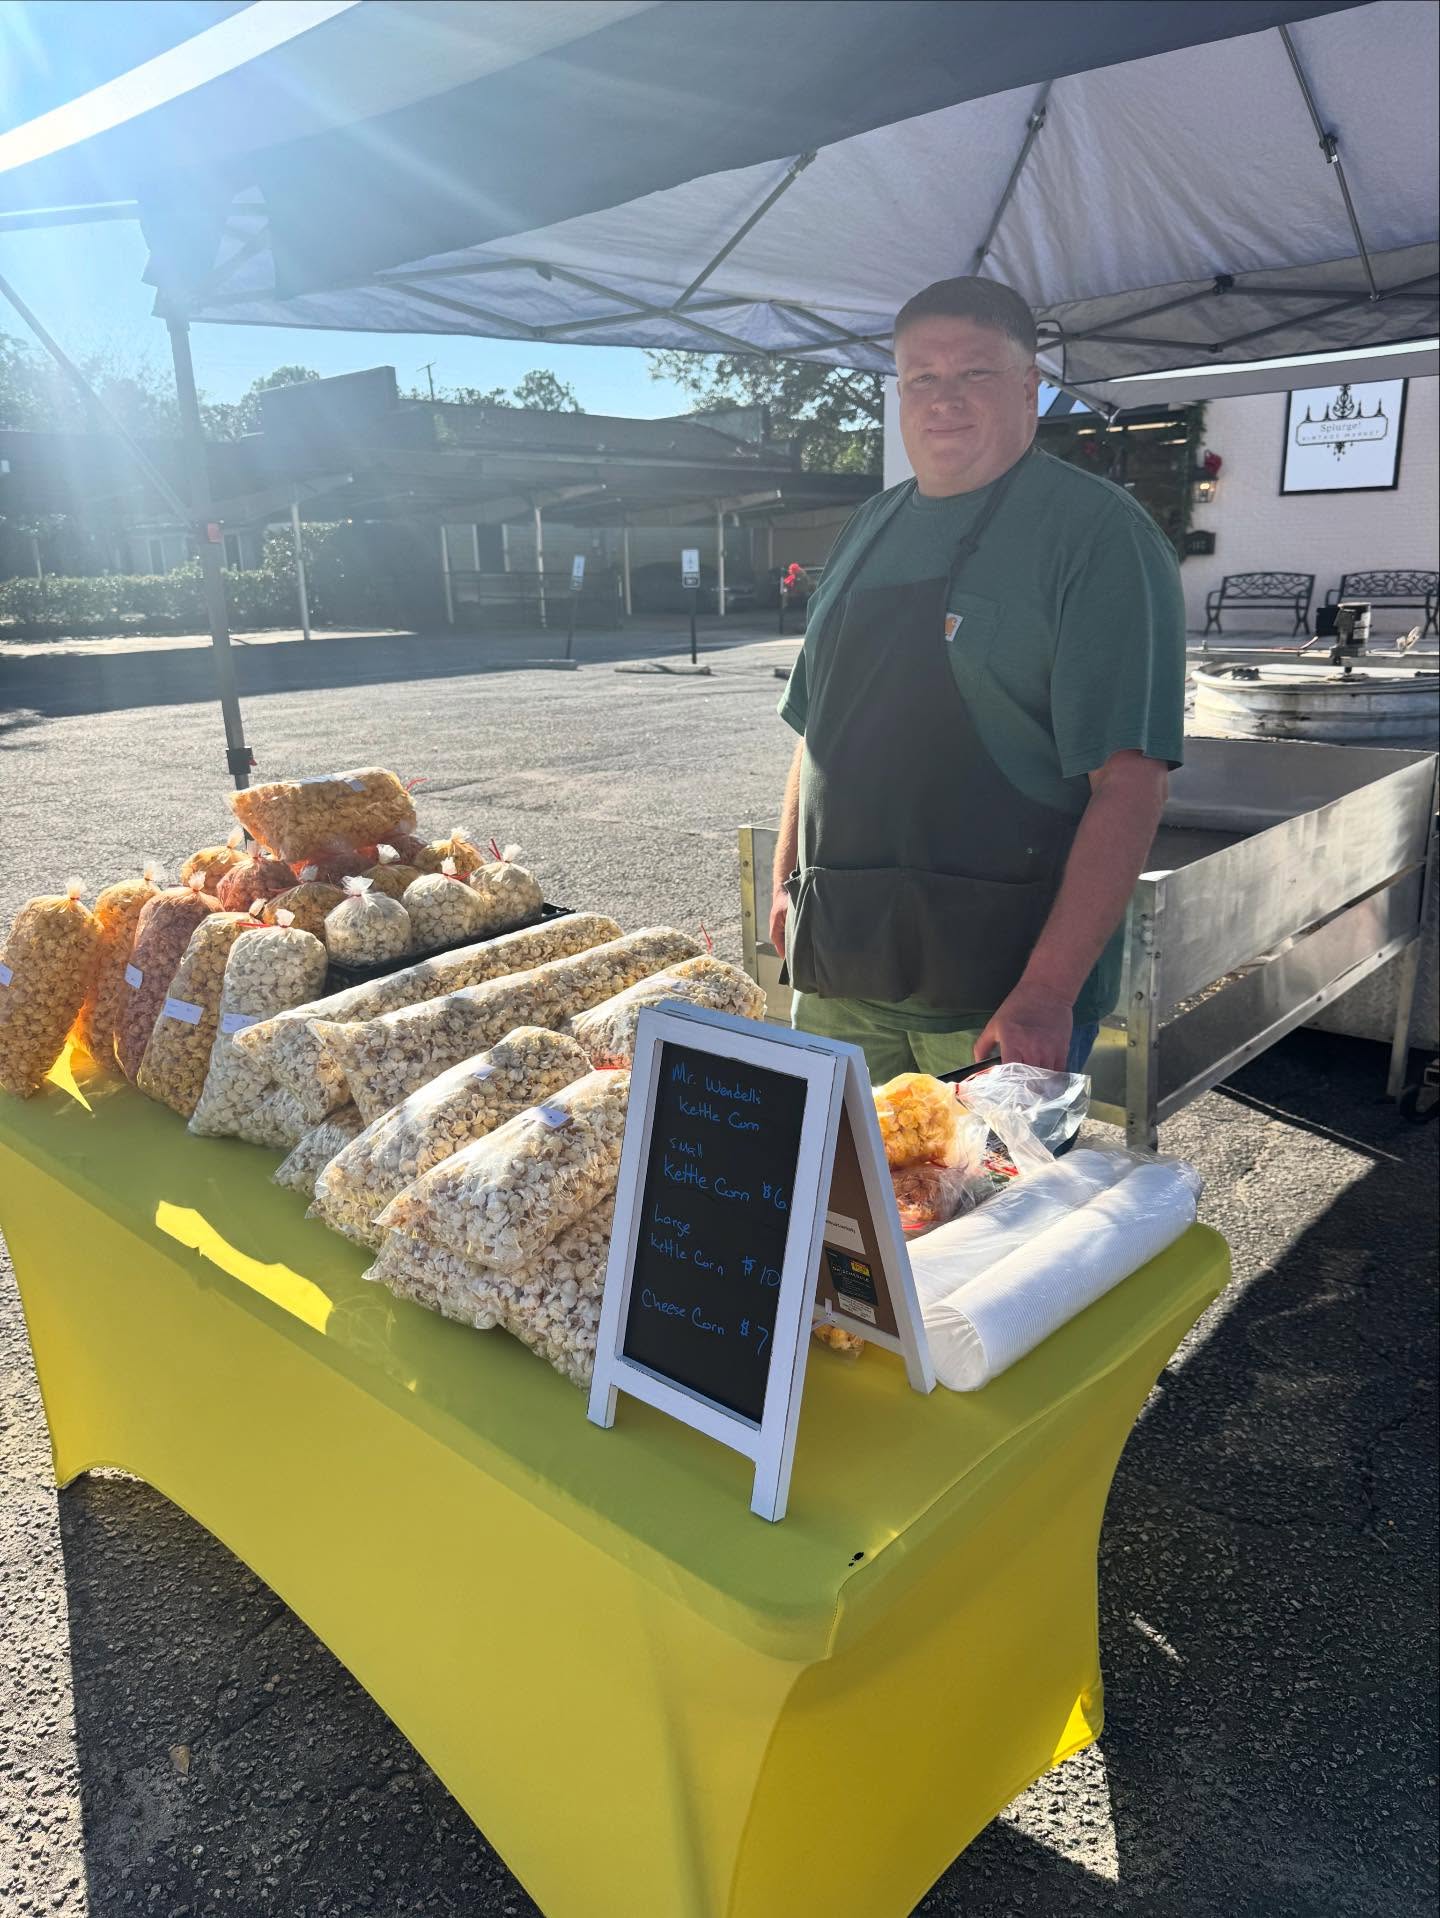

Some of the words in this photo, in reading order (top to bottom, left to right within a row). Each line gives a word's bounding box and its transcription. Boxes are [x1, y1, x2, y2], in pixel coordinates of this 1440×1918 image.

[671, 1061, 696, 1085] Mr.
[727, 1111, 760, 1130] Corn
[714, 1177, 750, 1202] Corn
[654, 1203, 690, 1237] Large
[694, 1249, 724, 1275] Corn
[641, 1288, 686, 1318] Cheese
[691, 1306, 725, 1335] Corn
